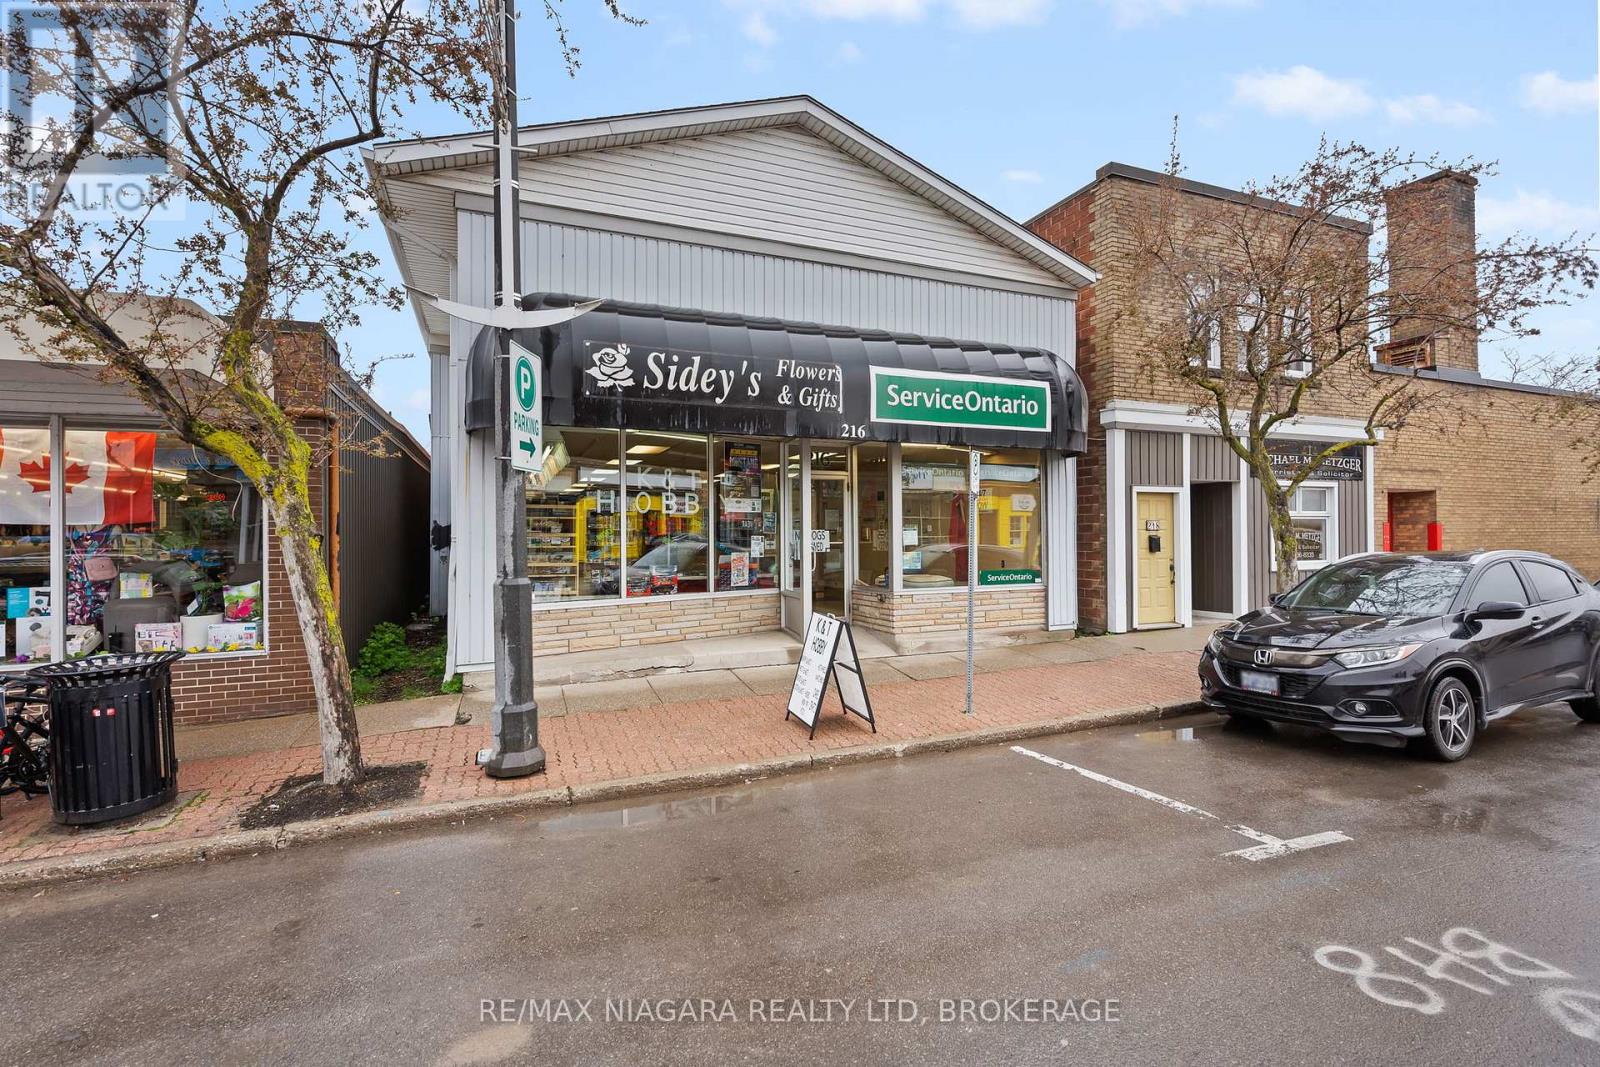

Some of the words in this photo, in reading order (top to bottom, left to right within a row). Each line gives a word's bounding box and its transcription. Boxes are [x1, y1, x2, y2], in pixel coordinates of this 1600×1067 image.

[643, 351, 762, 406] Sidey's
[777, 358, 841, 382] Flowers
[777, 386, 792, 405] &
[799, 387, 838, 412] Gifts
[886, 384, 1040, 416] ServiceOntario
[513, 411, 541, 438] PARKING
[841, 423, 866, 439] 216
[1268, 454, 1302, 466] CHAEL
[1322, 458, 1362, 473] ETZGER
[811, 530, 826, 541] OGS
[987, 572, 1033, 582] ServiceOntario
